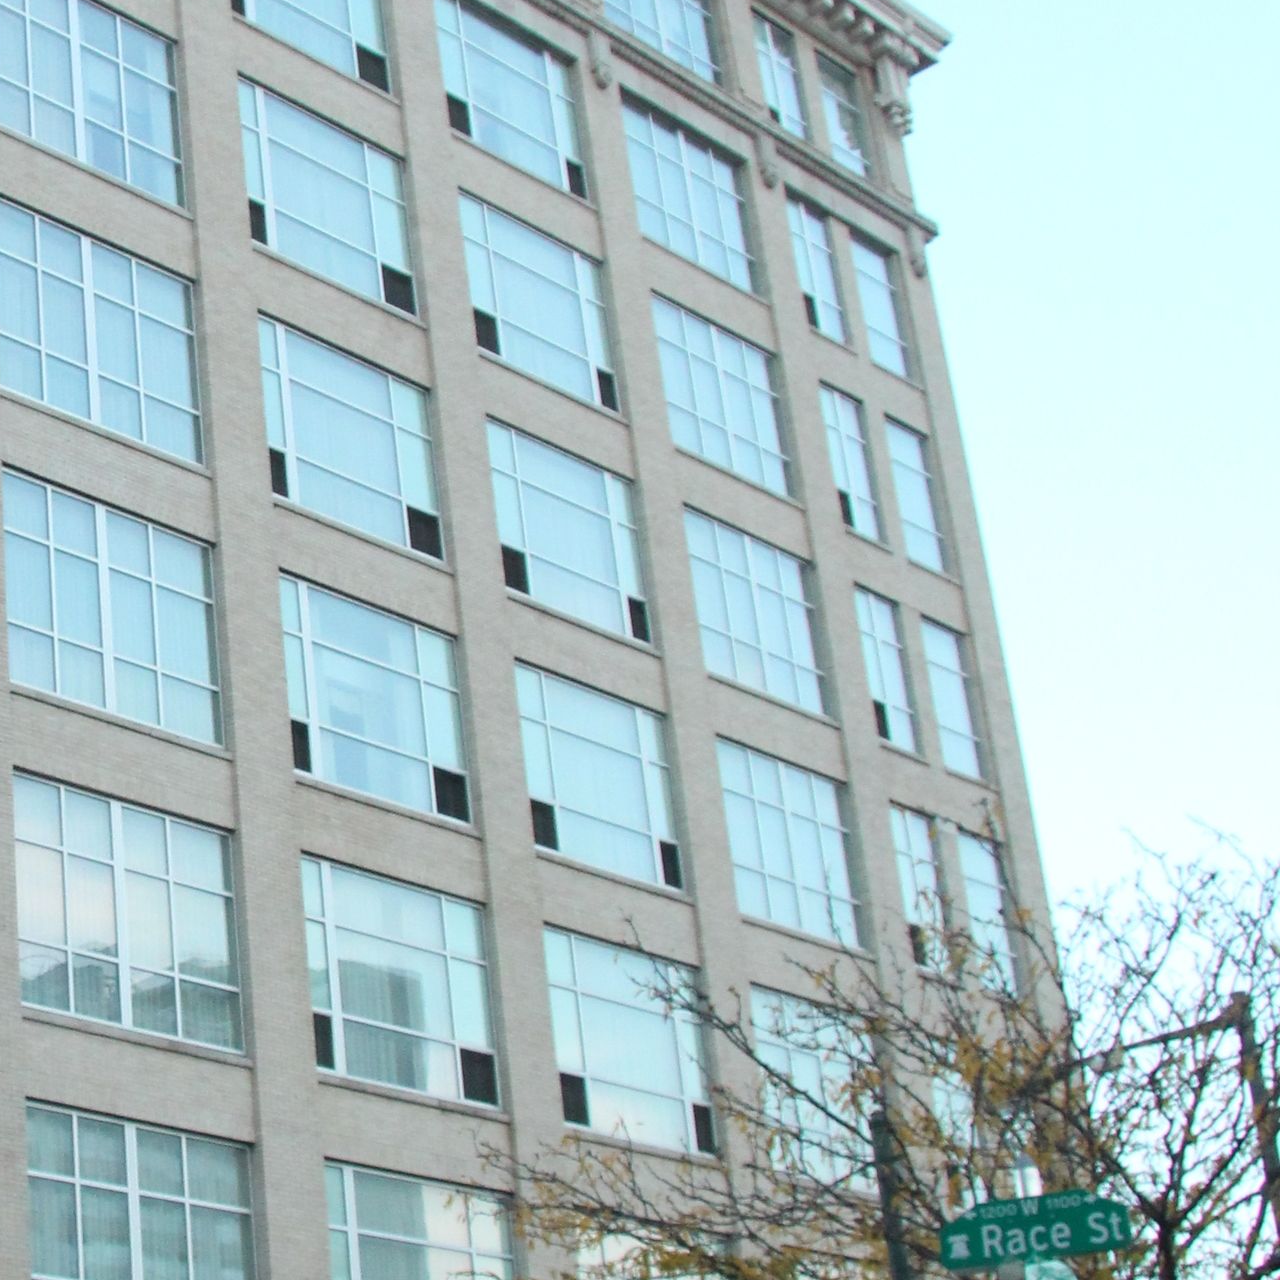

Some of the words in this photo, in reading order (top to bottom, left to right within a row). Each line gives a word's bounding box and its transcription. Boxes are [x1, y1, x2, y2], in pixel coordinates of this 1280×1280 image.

[980, 1204, 1017, 1219] 1200
[1021, 1198, 1039, 1216] W
[980, 1221, 1072, 1258] Race
[1087, 1211, 1125, 1245] St
